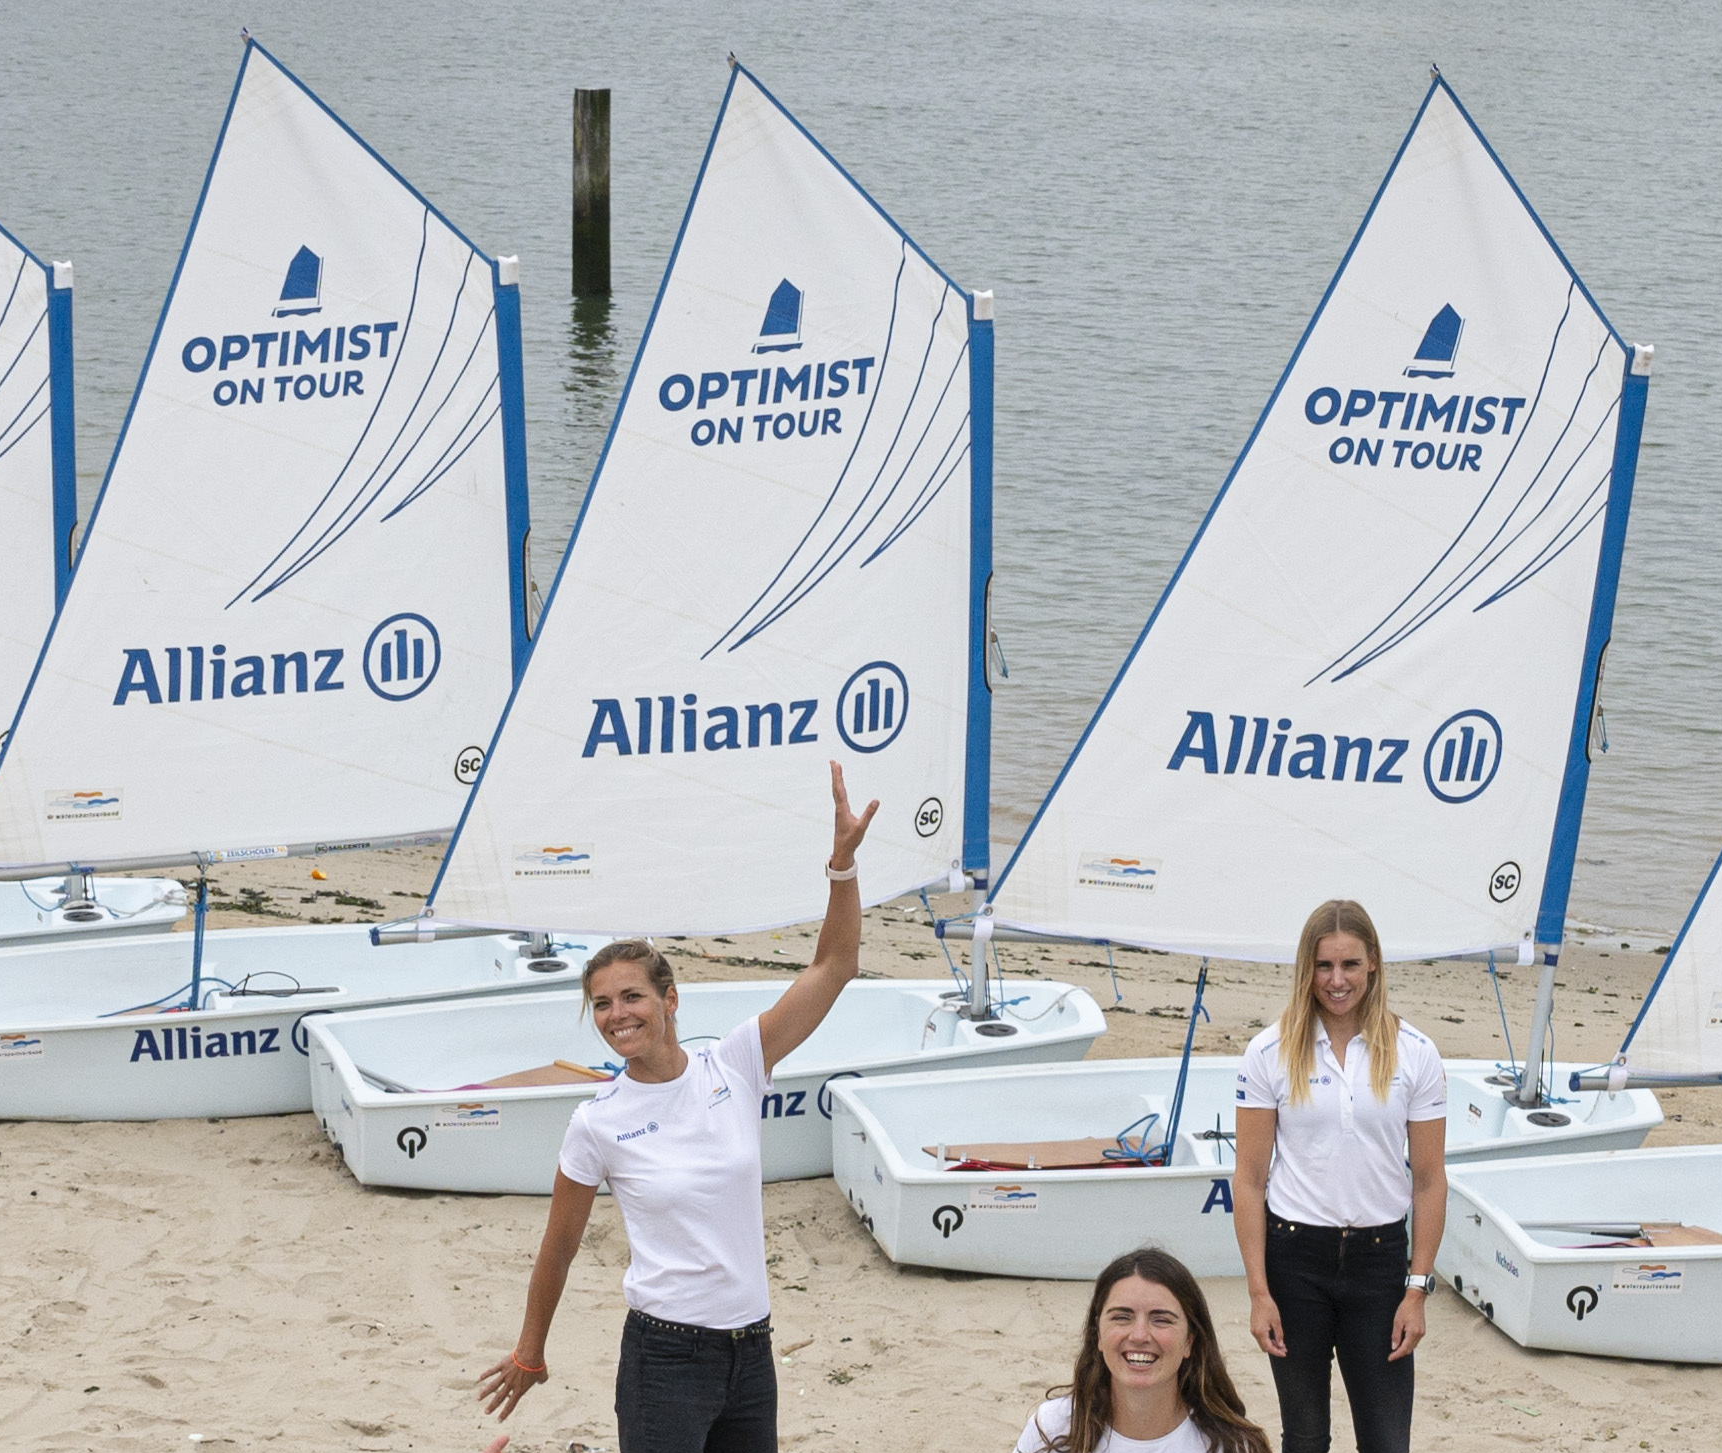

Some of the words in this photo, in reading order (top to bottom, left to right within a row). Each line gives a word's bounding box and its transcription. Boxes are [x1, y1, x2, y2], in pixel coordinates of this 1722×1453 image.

[182, 322, 398, 374] OPTIMIST
[213, 379, 264, 406] ON
[273, 370, 365, 402] TOUR
[658, 357, 875, 412] OPTIMIST
[690, 418, 743, 446] ON
[755, 408, 842, 441] TOUR
[1305, 387, 1525, 435] OPTIMIST
[1328, 437, 1384, 467] ON
[1392, 440, 1482, 472] TOUR
[112, 644, 345, 706] Allianz
[581, 693, 818, 758] Allianz
[1166, 710, 1409, 783] Allianz
[461, 758, 480, 773] SC
[918, 809, 940, 827] SC
[1494, 873, 1516, 890] SC
[129, 1028, 280, 1062] Allianz
[617, 1128, 646, 1142] Allianz
